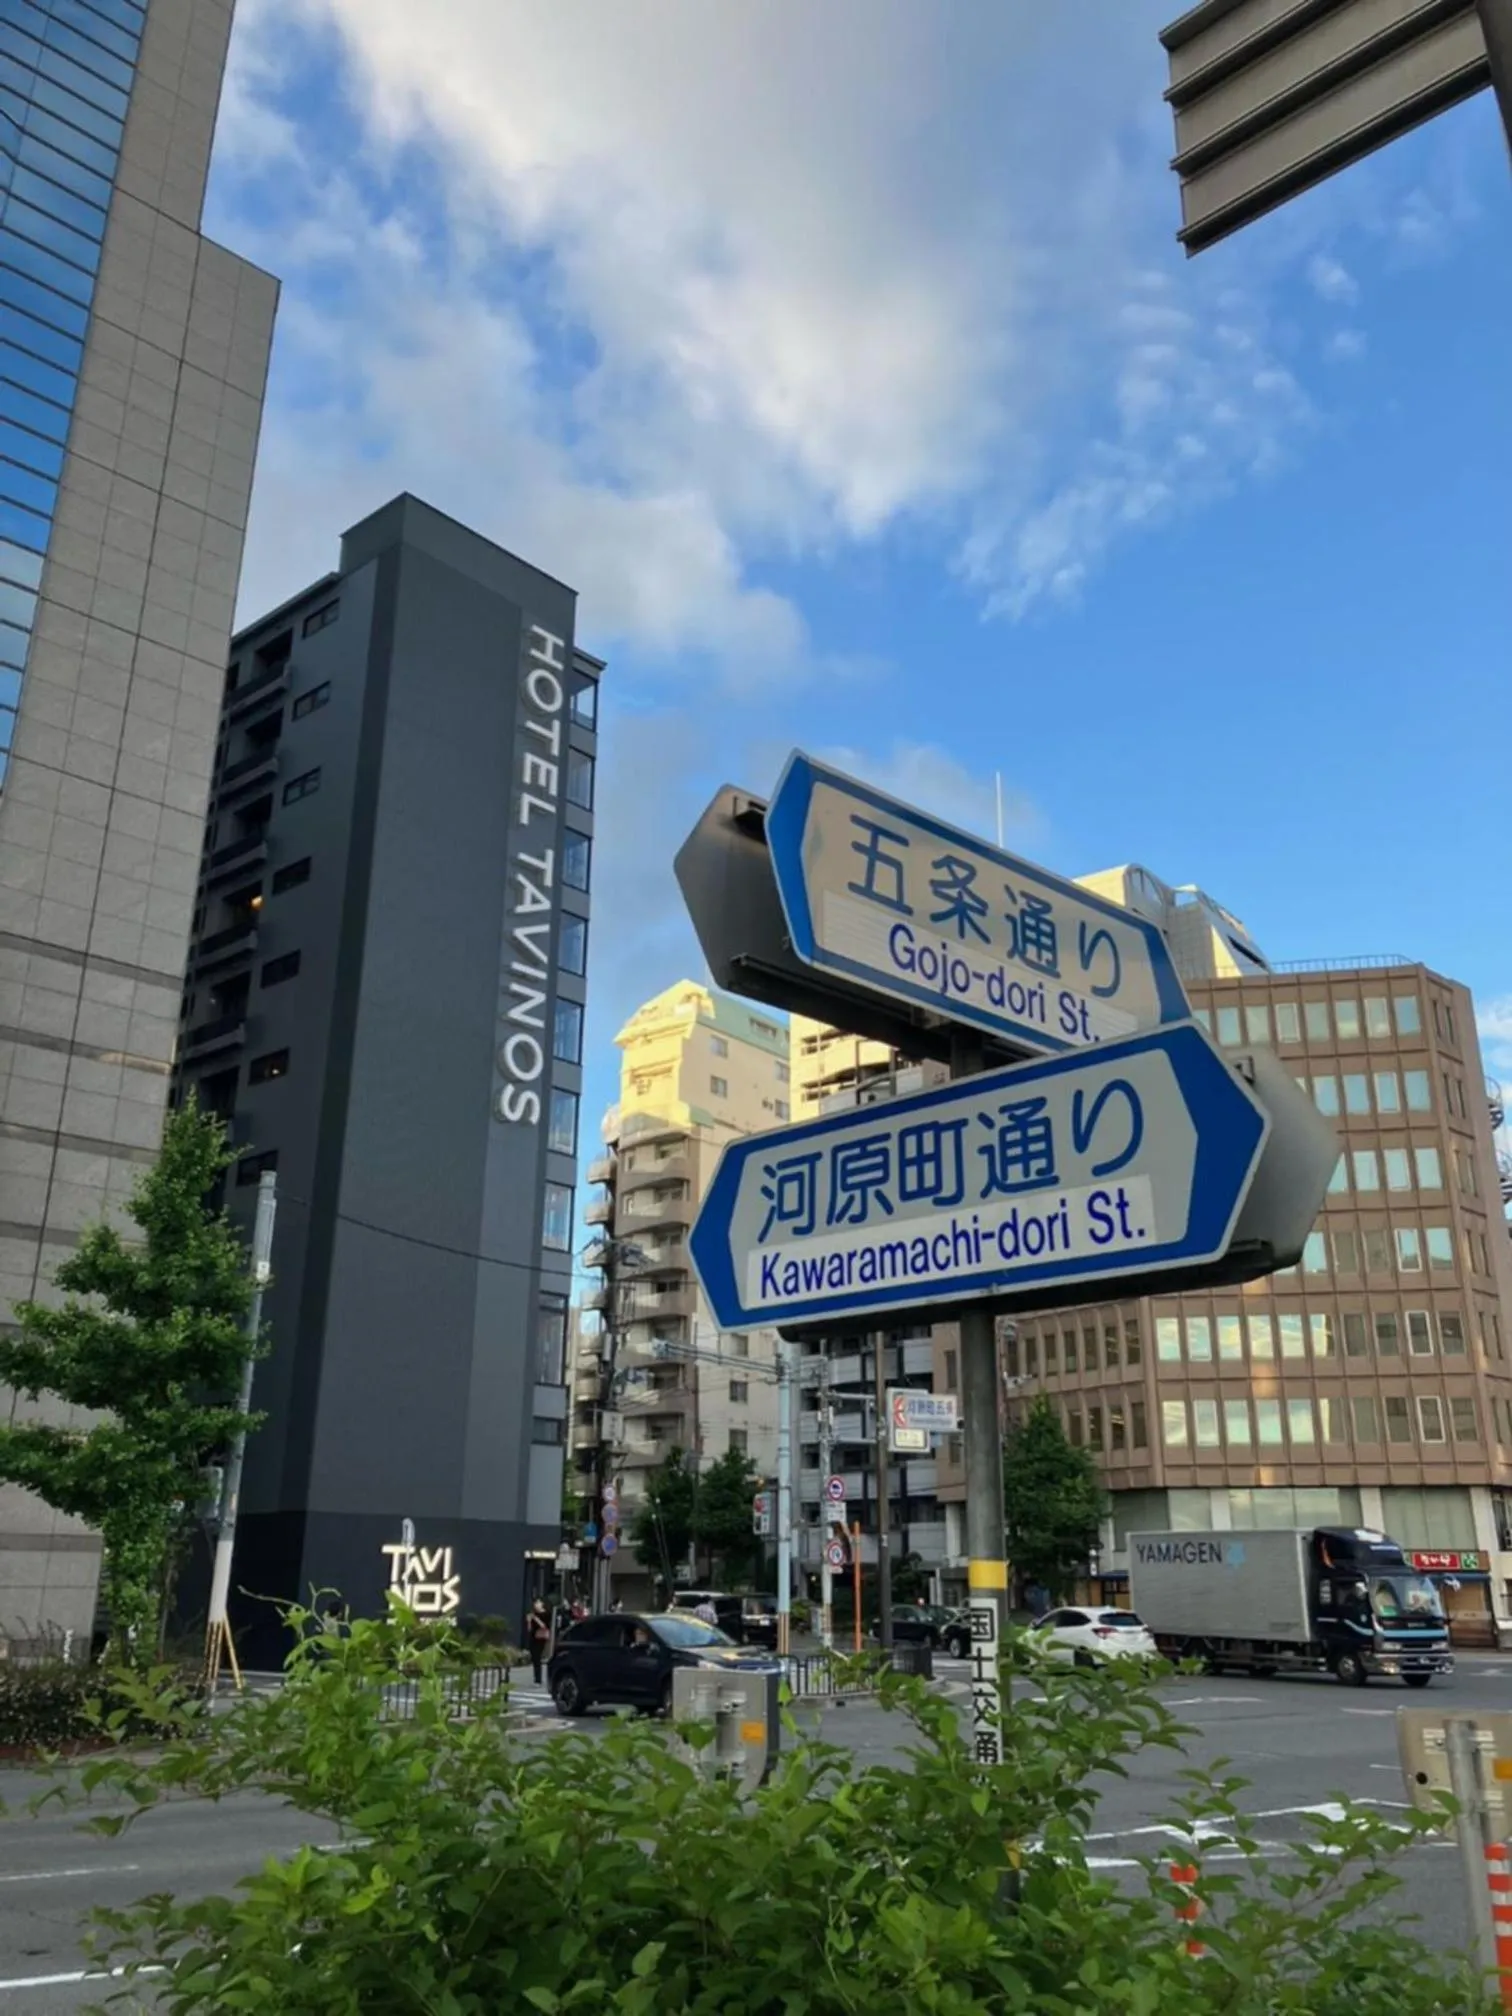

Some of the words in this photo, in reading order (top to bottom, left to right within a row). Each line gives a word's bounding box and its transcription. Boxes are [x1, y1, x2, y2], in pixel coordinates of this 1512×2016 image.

[519, 624, 565, 826] HOTEL
[850, 813, 1122, 999] 五条通り
[500, 848, 555, 1126] TAVINOS
[888, 923, 1047, 1021] Gojo-dori
[1058, 991, 1101, 1042] St.
[756, 1077, 1145, 1244] 河原町通り
[760, 1199, 1071, 1300] Kawaramachi-dori
[1088, 1188, 1147, 1245] St.
[381, 1545, 453, 1582] TAVI
[389, 1574, 461, 1613] NOS
[1136, 1541, 1223, 1564] YAMAGEN
